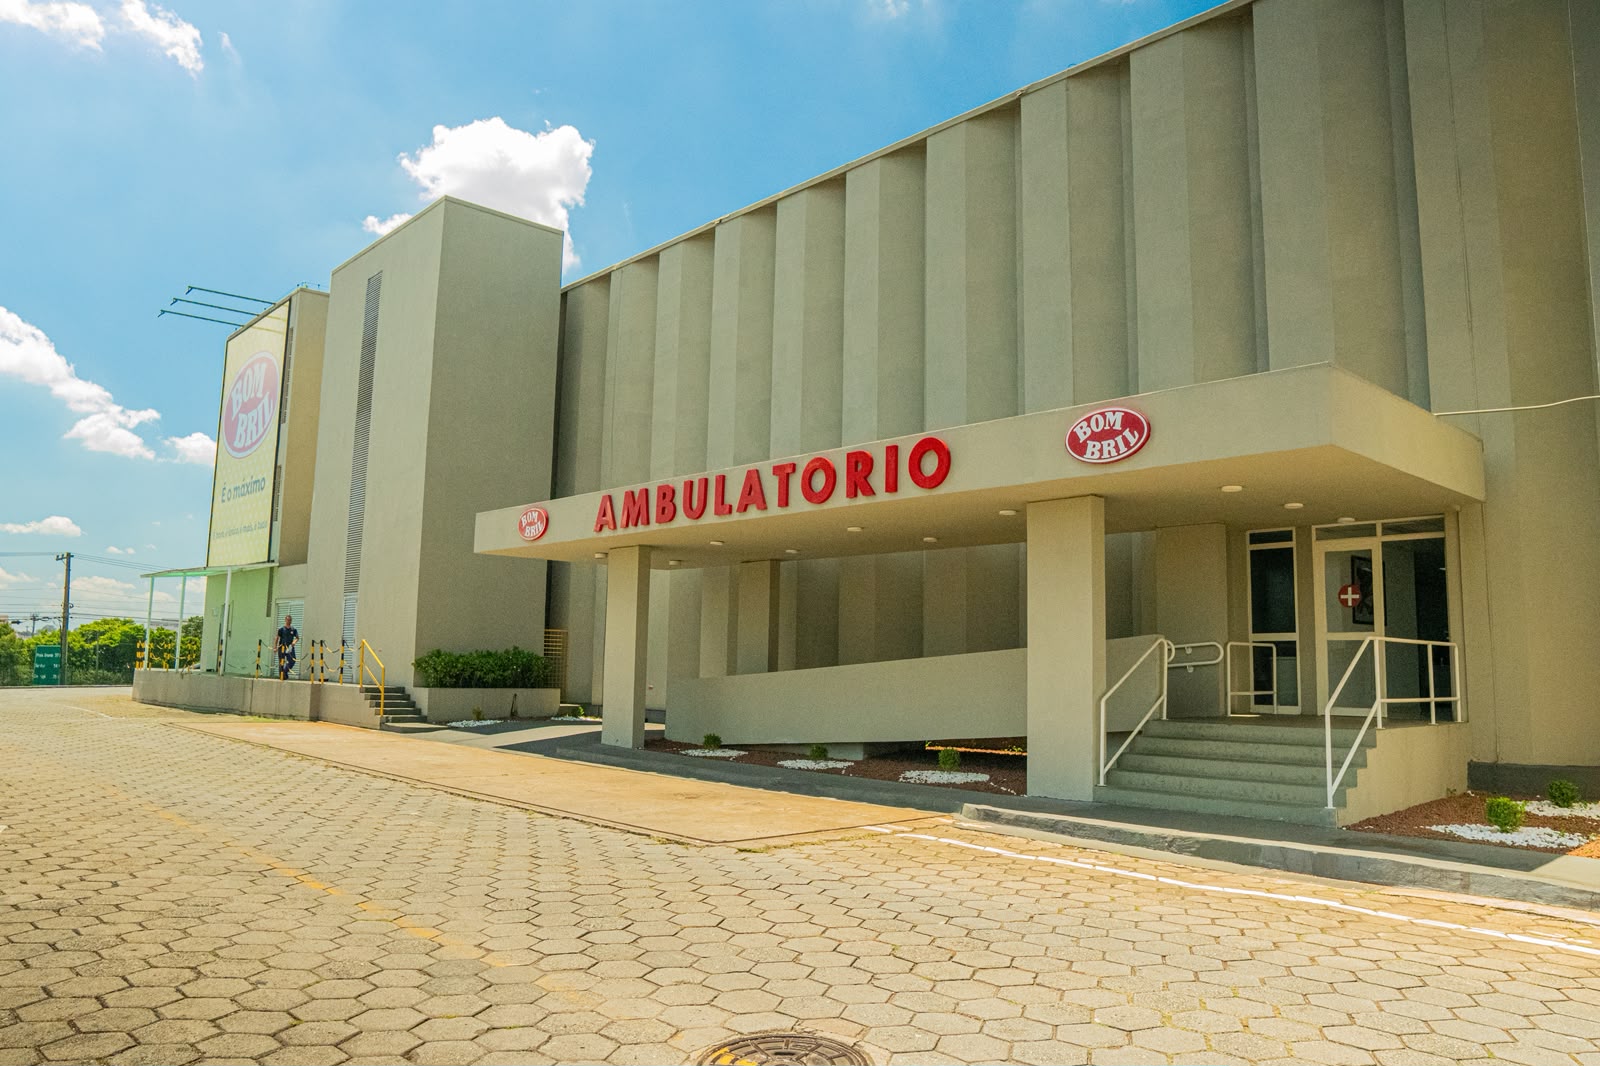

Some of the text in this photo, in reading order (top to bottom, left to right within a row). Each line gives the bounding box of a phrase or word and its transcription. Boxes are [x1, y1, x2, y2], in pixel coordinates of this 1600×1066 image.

[231, 363, 267, 421] BOM
[233, 392, 273, 449] BRIL
[1074, 411, 1124, 443] BOM
[1084, 428, 1139, 459] BRIL
[221, 475, 265, 503] É o máximo
[595, 437, 951, 533] AMBULATORIO
[521, 511, 538, 527] BOM
[523, 521, 543, 536] BRIL
